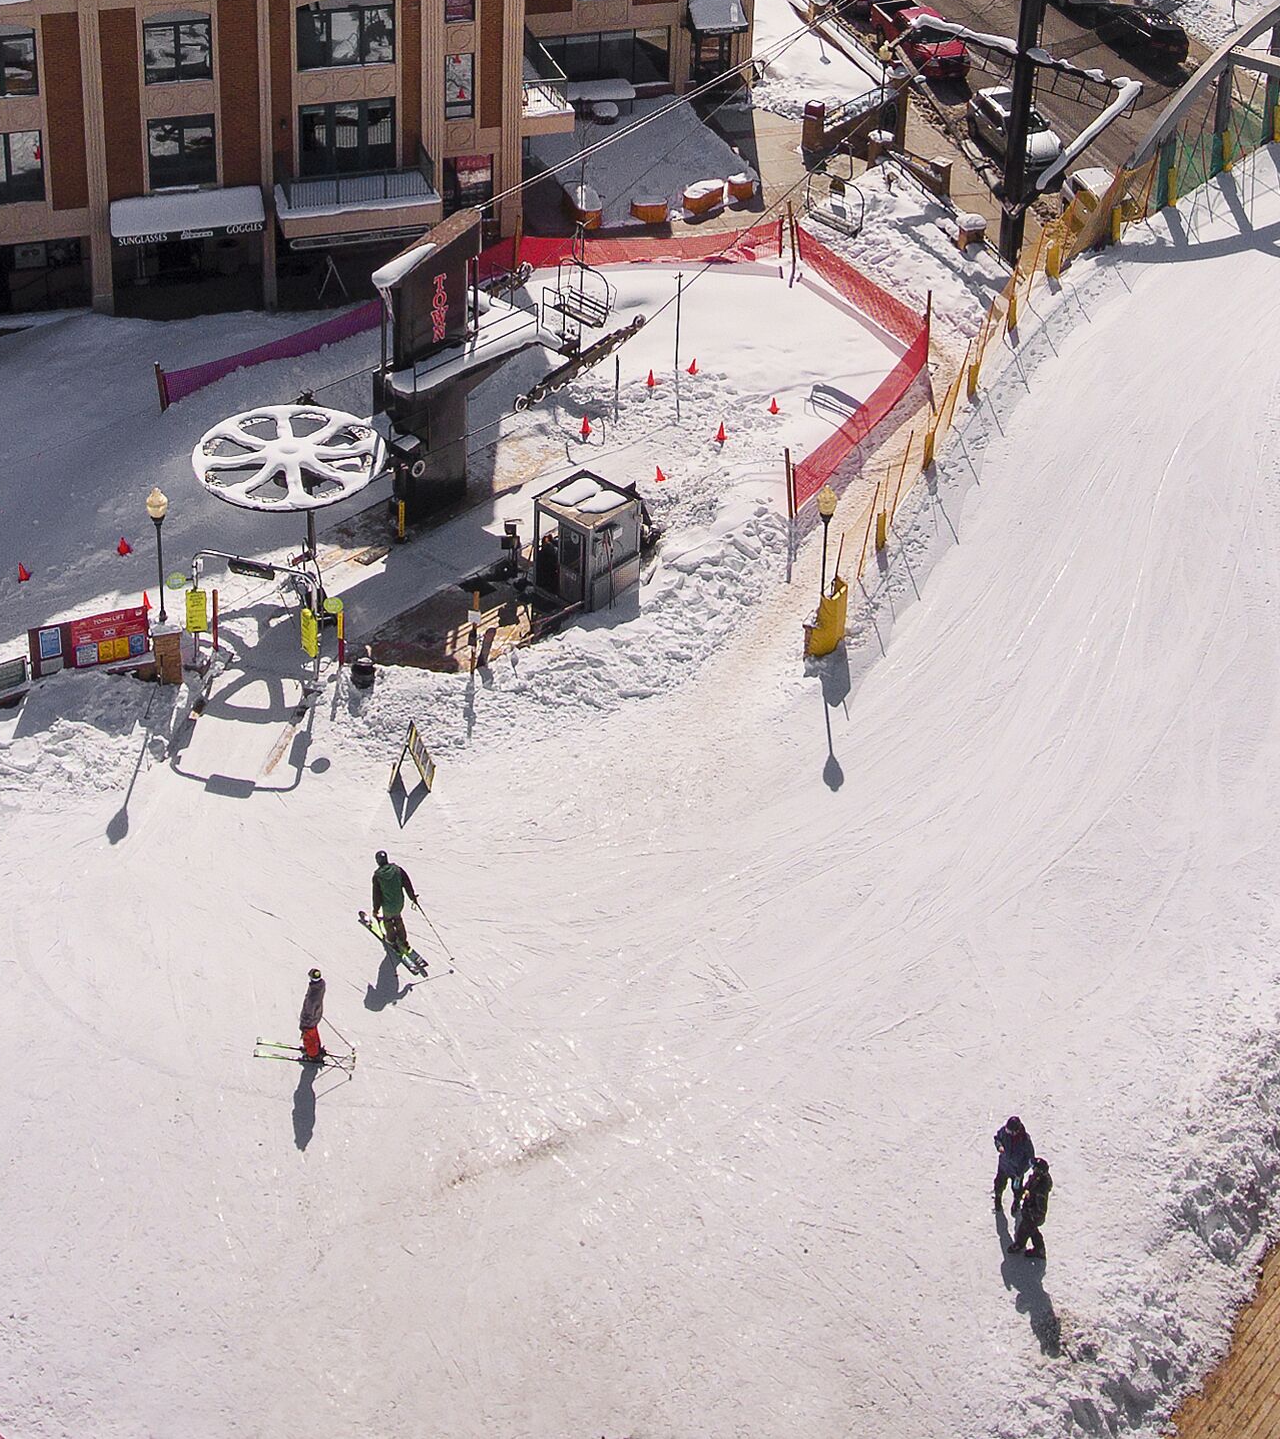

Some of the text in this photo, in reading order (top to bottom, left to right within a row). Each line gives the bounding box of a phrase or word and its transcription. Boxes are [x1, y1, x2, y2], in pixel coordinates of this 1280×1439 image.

[118, 233, 168, 246] SUNGLASSES
[226, 222, 263, 234] GOGGLES
[430, 272, 449, 344] TOWN
